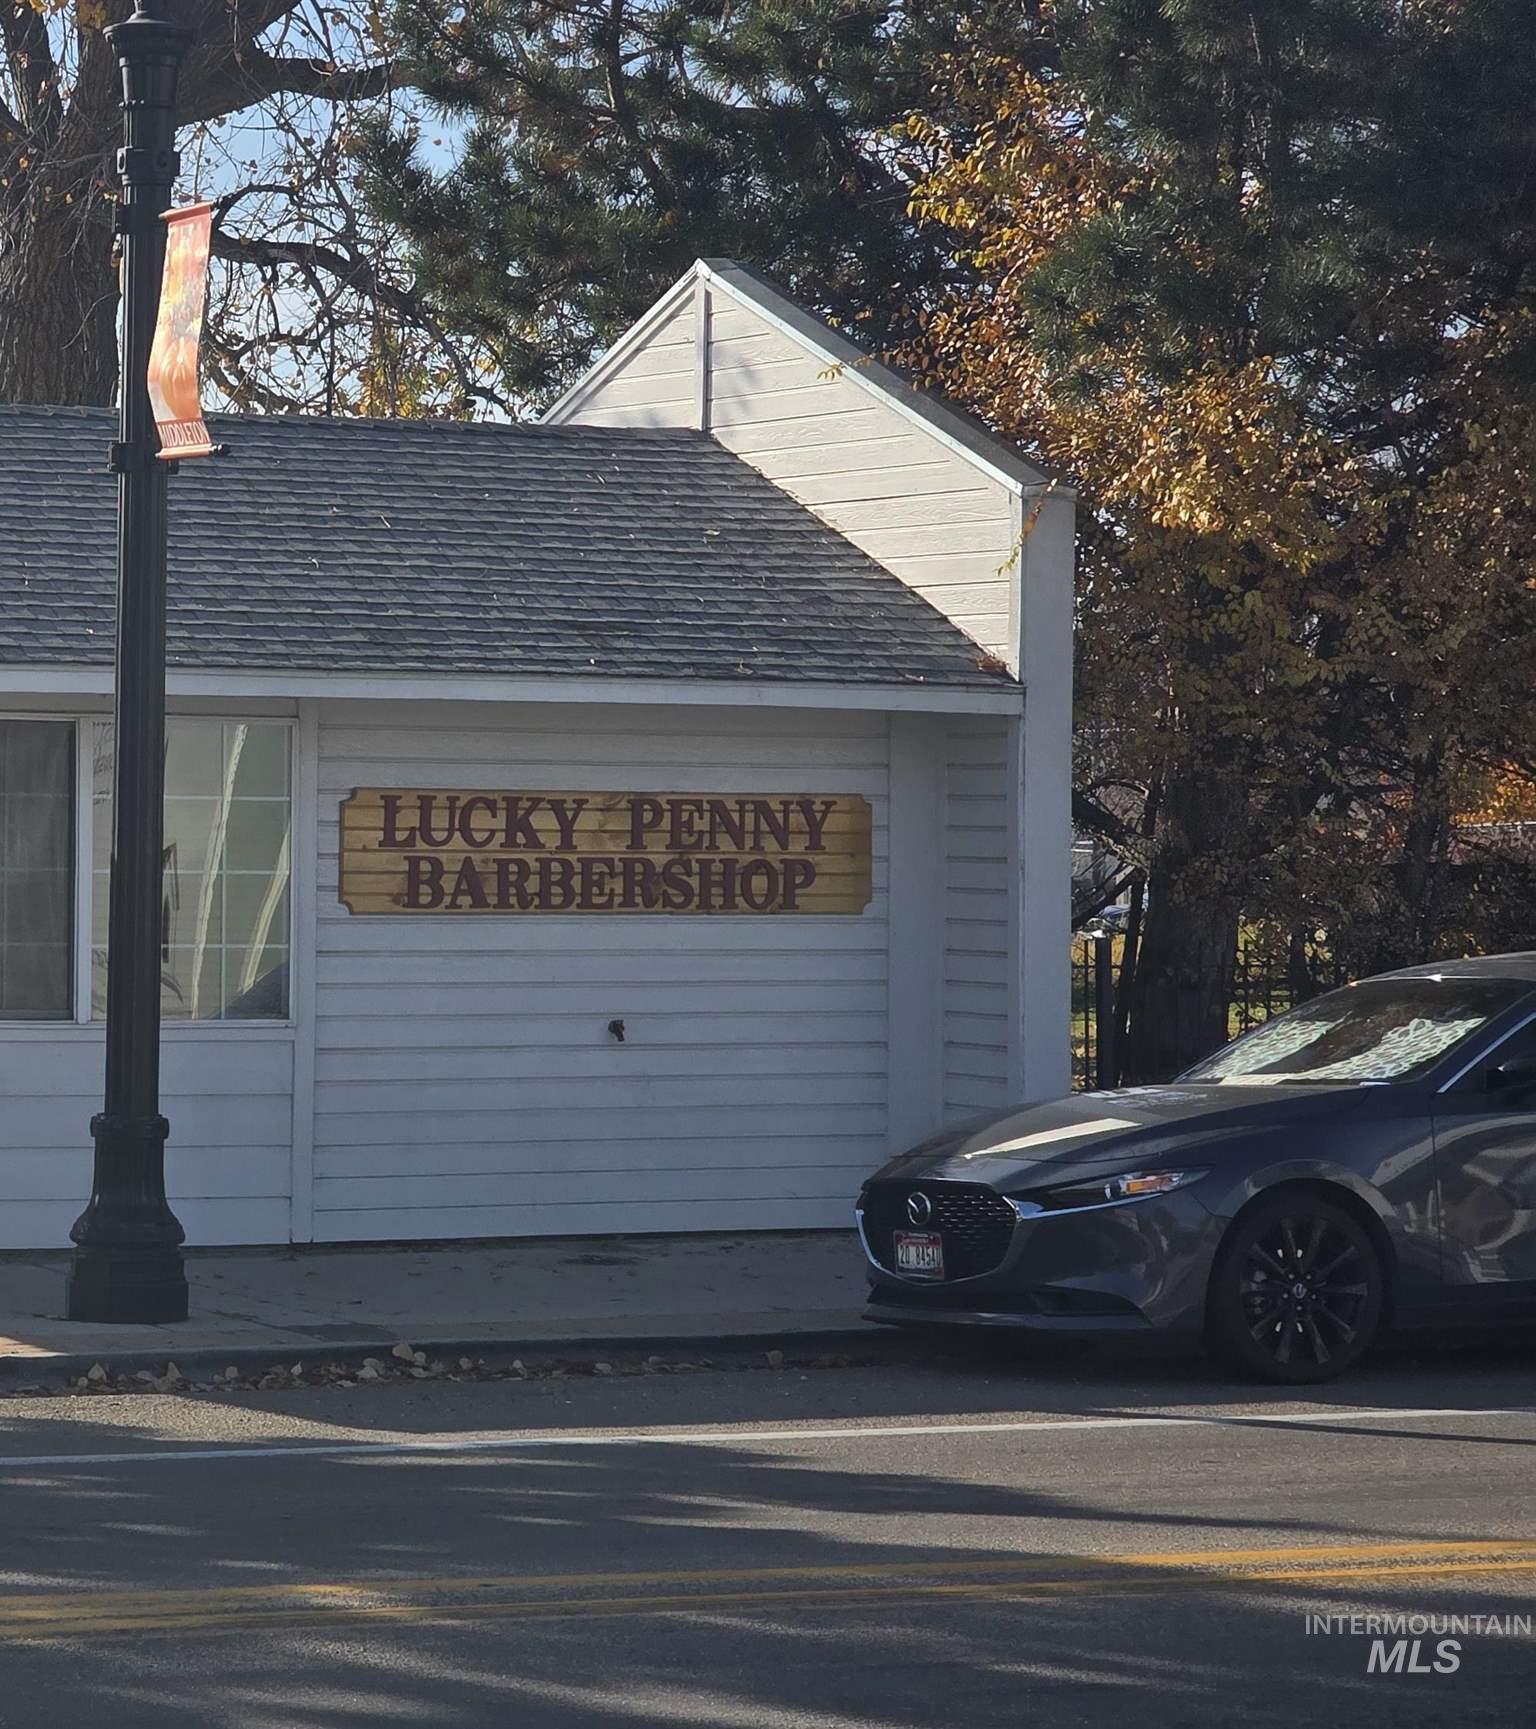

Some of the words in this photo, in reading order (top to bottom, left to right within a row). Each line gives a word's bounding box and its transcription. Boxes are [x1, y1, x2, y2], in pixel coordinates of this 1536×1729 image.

[378, 794, 589, 850] LUCKY
[626, 799, 838, 851] PENNY
[401, 855, 817, 911] BARBERSHOP
